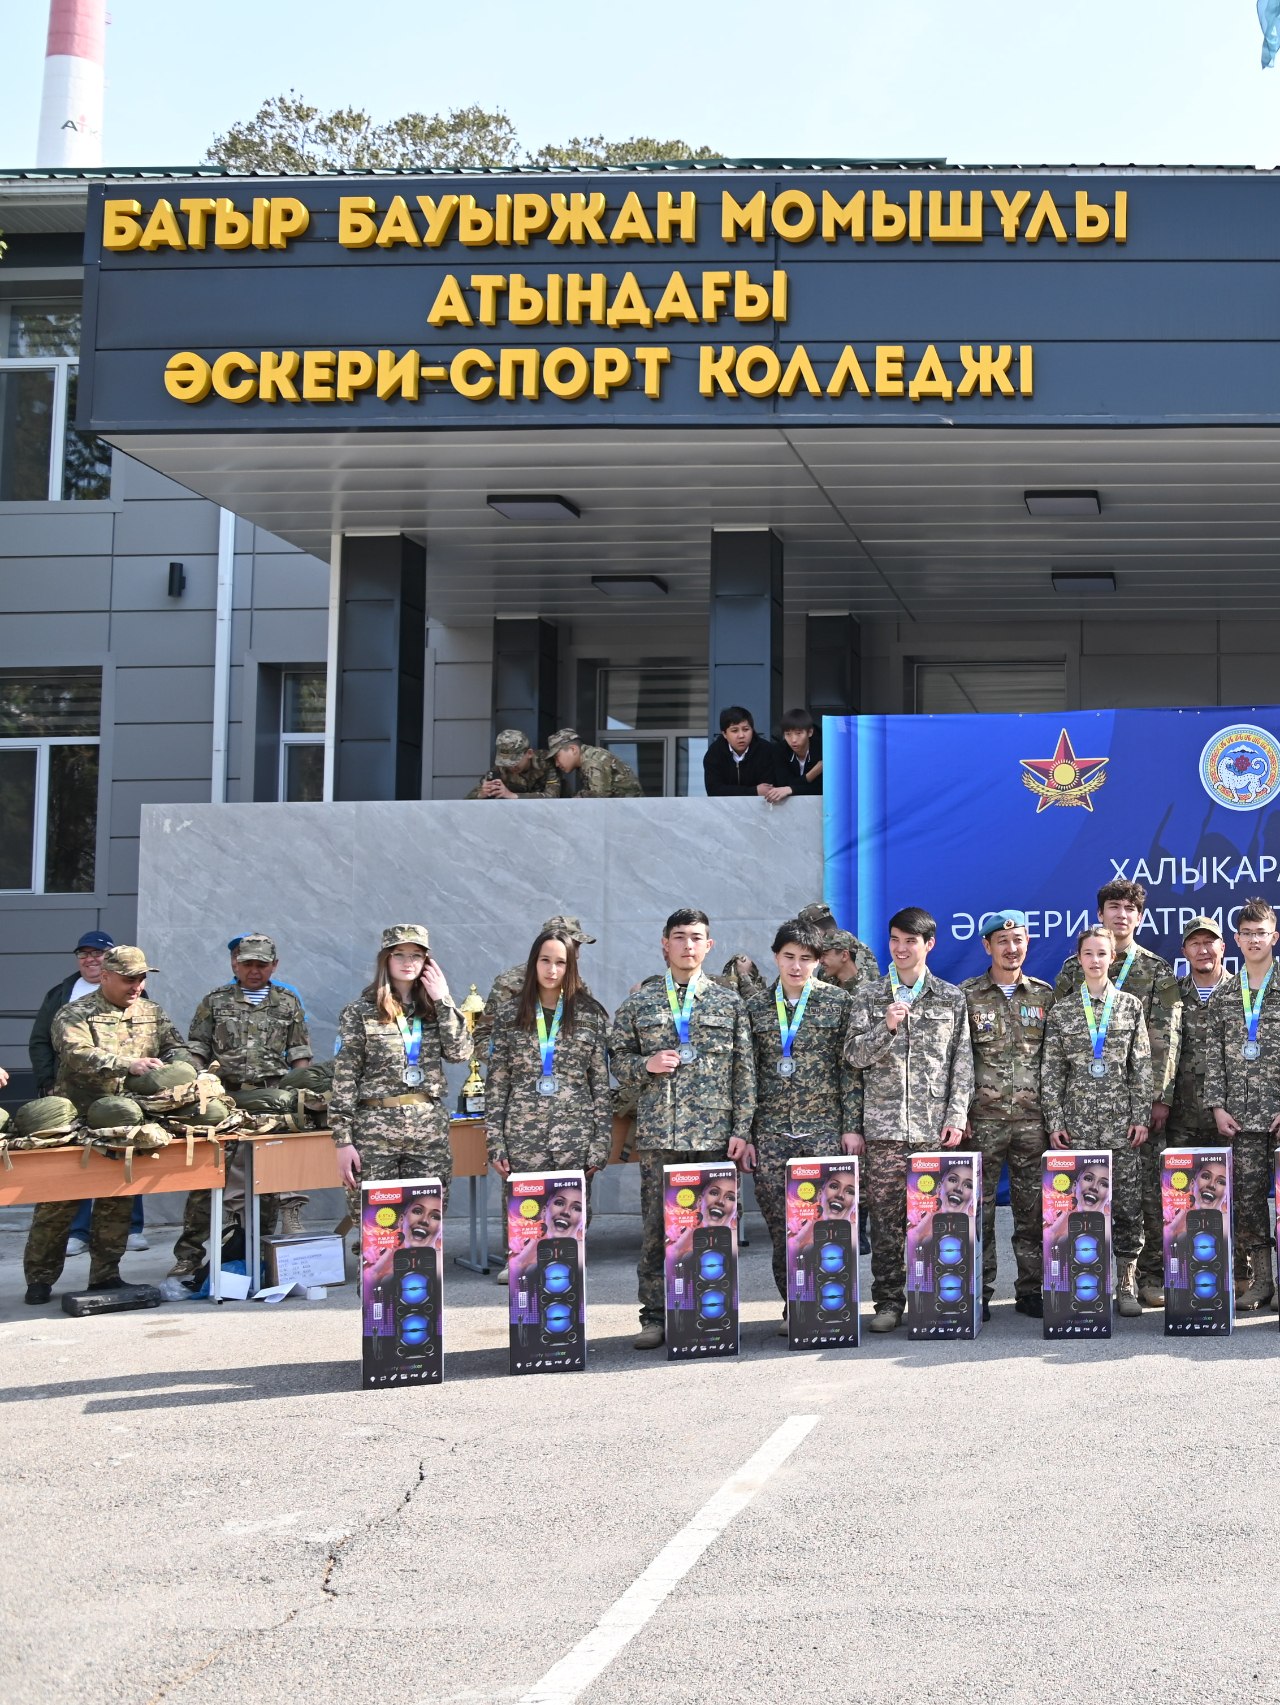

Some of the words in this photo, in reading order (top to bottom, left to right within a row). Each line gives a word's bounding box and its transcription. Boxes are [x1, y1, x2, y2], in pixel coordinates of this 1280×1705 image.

[103, 197, 309, 250] БАТЫР
[339, 191, 696, 249] БАУЫРЖАН
[722, 189, 1128, 243] МОМЫШҰЛЫ
[428, 269, 788, 329] АТЫНДАҒЫ
[165, 345, 671, 404] ӘСКЕРИ-СПОРТ
[700, 345, 1034, 402] КОЛЛЕДЖІ
